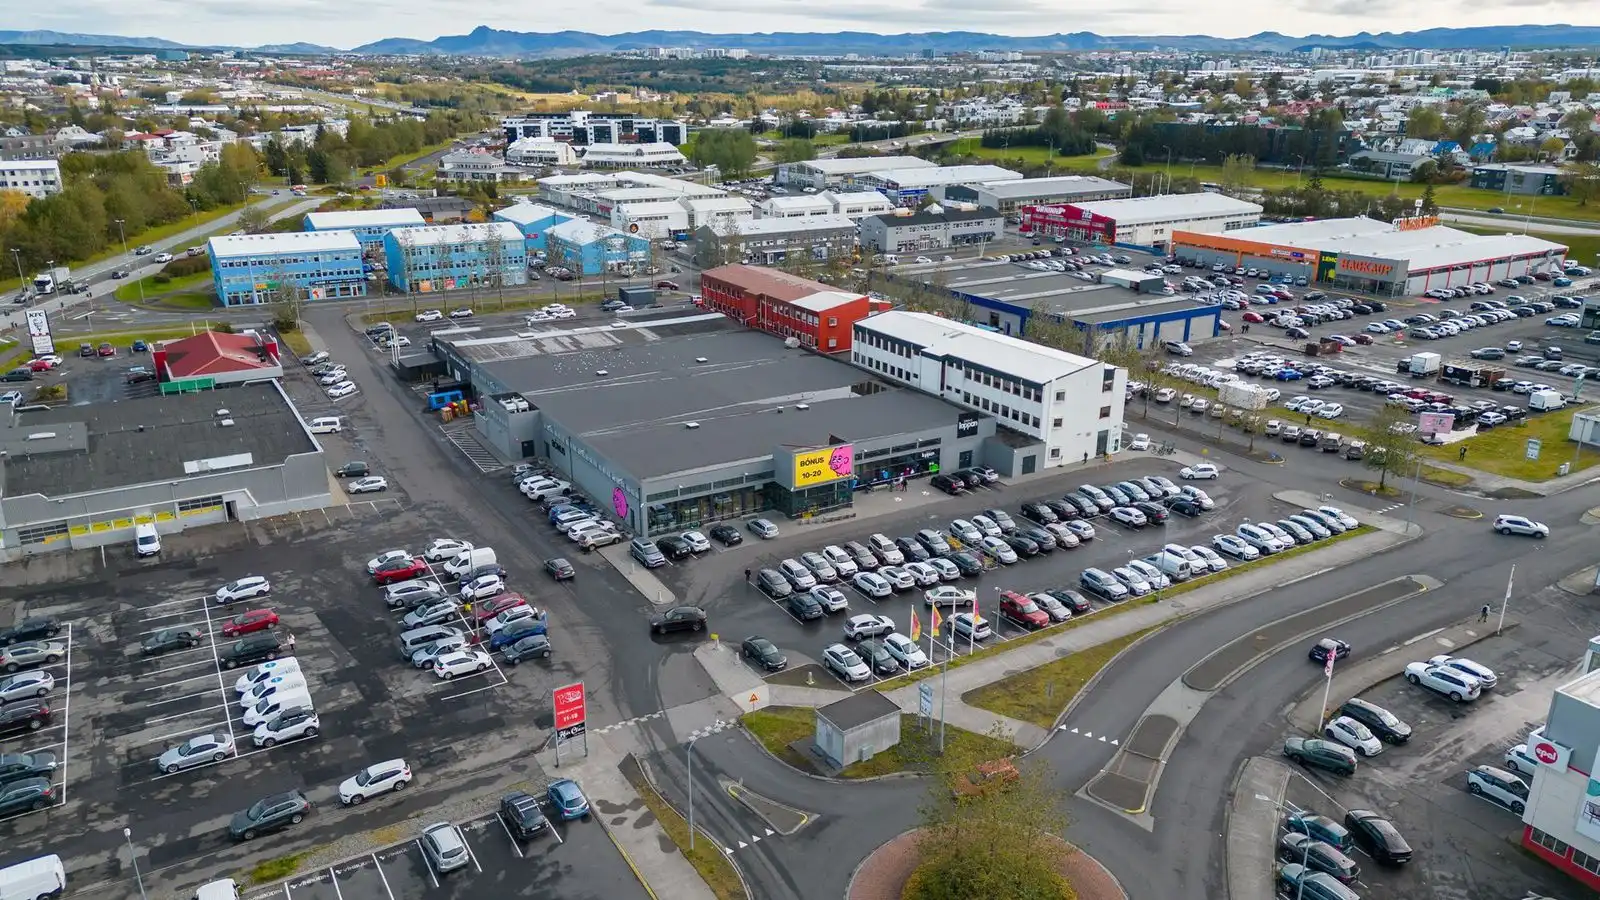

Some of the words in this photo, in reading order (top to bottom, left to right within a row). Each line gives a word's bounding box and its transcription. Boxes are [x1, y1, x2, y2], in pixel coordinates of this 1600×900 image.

[800, 457, 825, 467] BÓNUS
[802, 470, 822, 479] 10-20
[1535, 747, 1557, 760] epal
